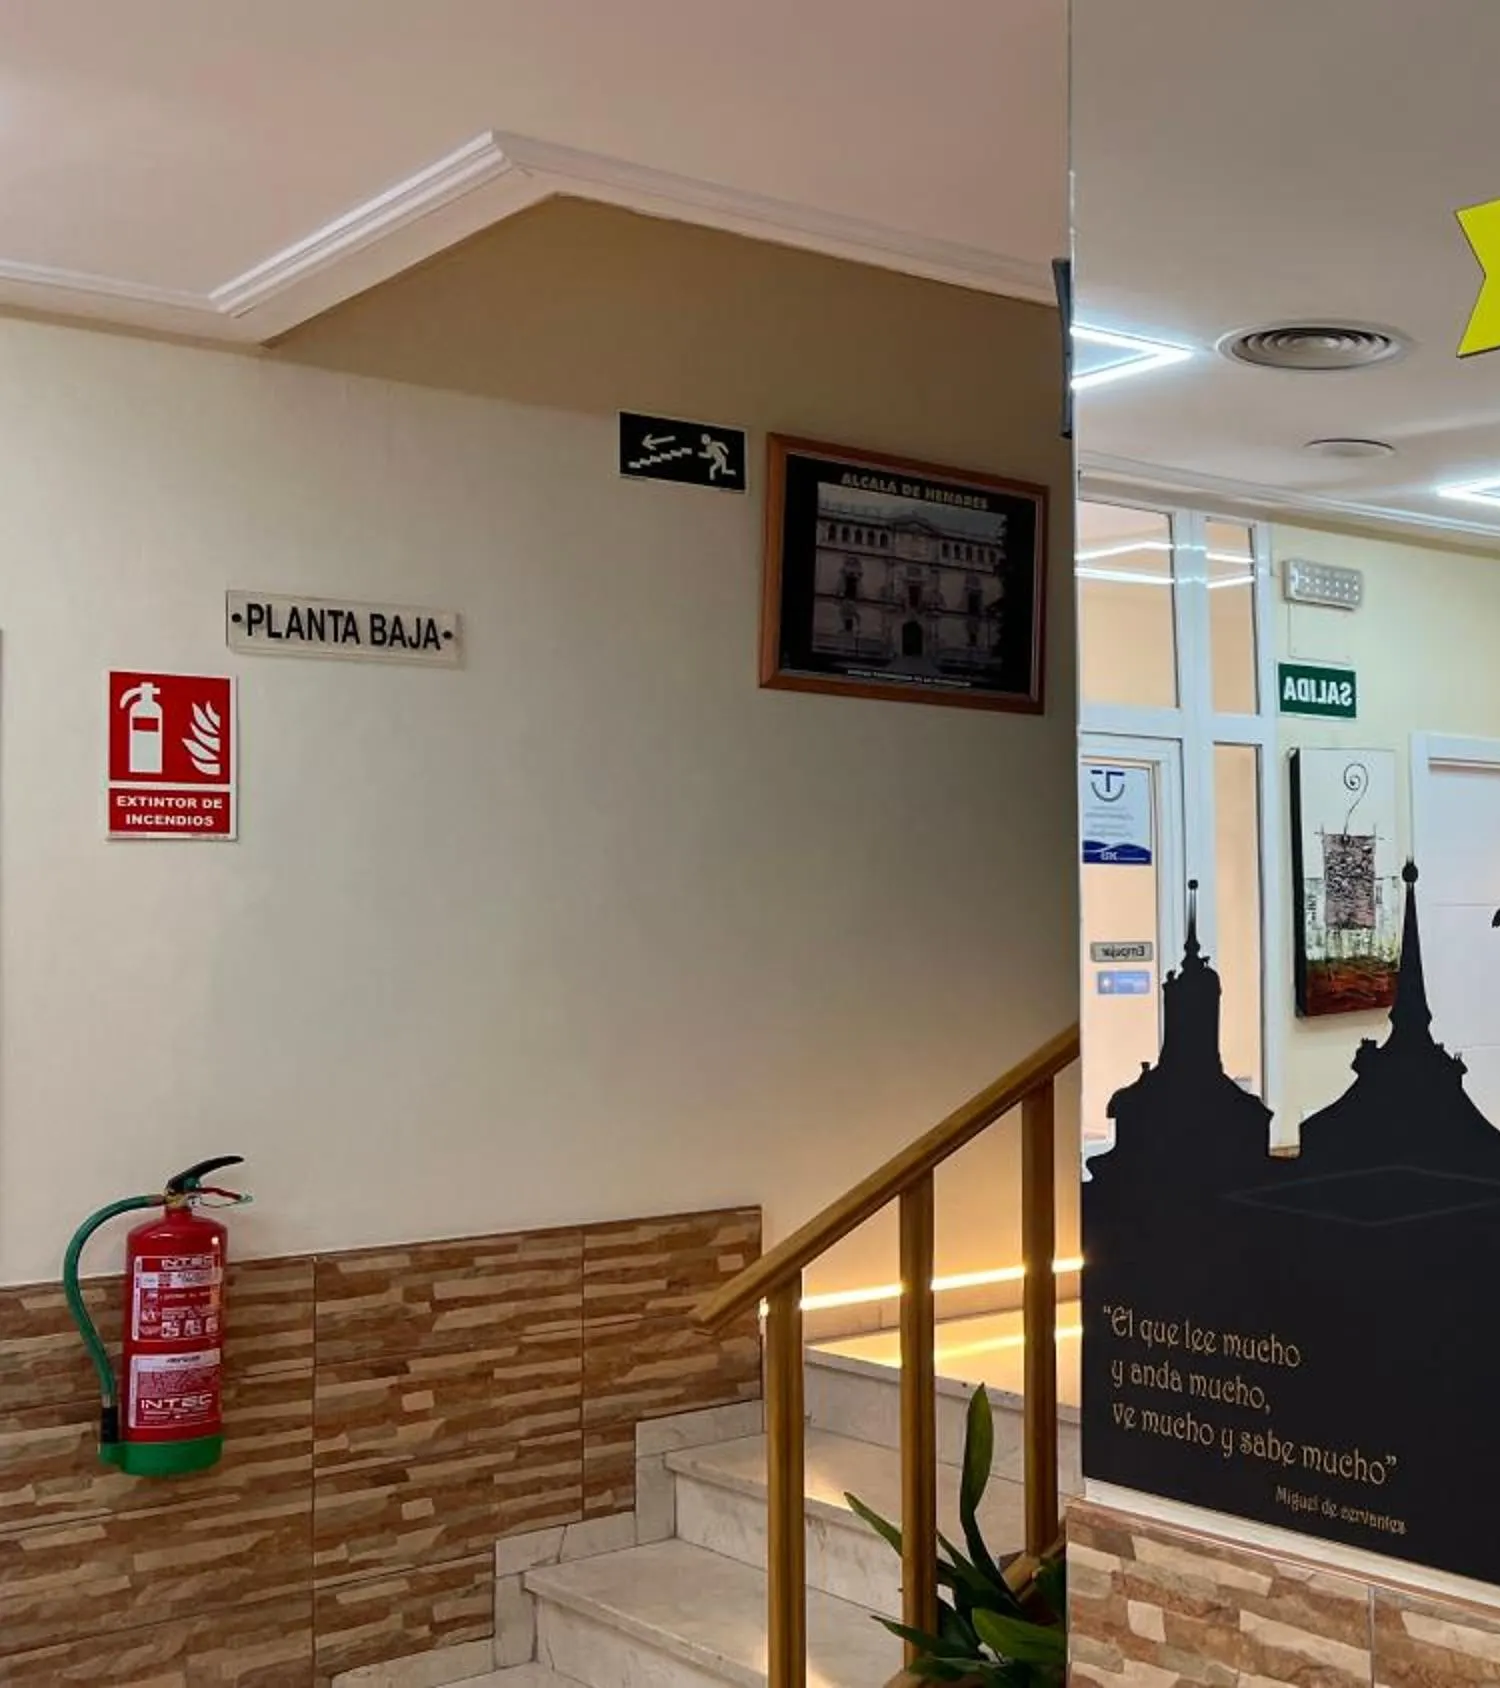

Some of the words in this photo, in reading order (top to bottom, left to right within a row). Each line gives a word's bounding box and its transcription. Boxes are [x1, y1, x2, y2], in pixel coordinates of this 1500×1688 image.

[901, 484, 922, 499] DE
[925, 487, 990, 511] HENARES
[246, 603, 361, 645] PLANTA
[369, 612, 441, 651] BAJA
[116, 795, 198, 809] EXTINTOR
[201, 797, 223, 809] DE
[125, 813, 215, 827] INCENDIOS
[1140, 1318, 1179, 1348] que
[1185, 1320, 1217, 1357] lee
[1224, 1333, 1300, 1368] mucho
[1111, 1359, 1124, 1388] y
[1131, 1361, 1183, 1393] anda
[1189, 1373, 1271, 1414] mucho,
[1112, 1402, 1137, 1430] ve
[1142, 1409, 1214, 1446] mucho
[1221, 1427, 1234, 1458] y
[1240, 1429, 1298, 1468] sabe
[1321, 1499, 1338, 1518] de
